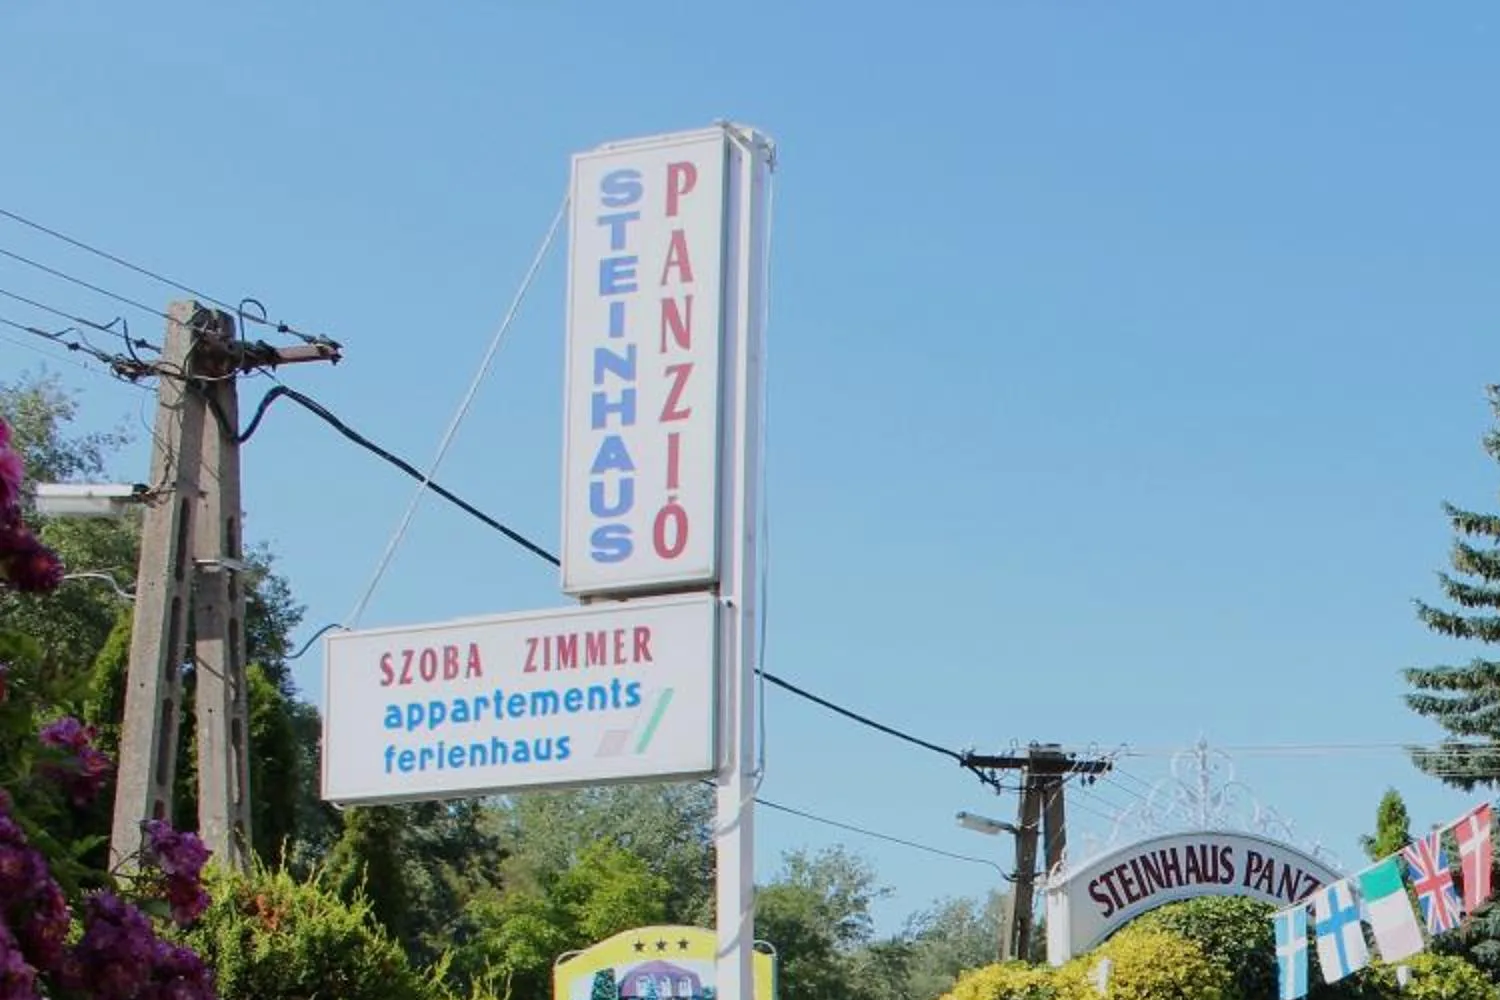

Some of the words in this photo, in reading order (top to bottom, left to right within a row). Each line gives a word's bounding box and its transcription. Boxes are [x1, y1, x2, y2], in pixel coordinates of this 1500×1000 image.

[588, 168, 643, 564] STEINHAUS
[653, 161, 698, 560] PANZIÓ
[379, 643, 483, 687] SZOBA
[523, 626, 653, 673] ZIMMER
[383, 677, 642, 731] appartements
[384, 735, 571, 774] ferienhaus
[1088, 844, 1235, 918] STEINHAUS
[1243, 849, 1322, 910] PANZ
